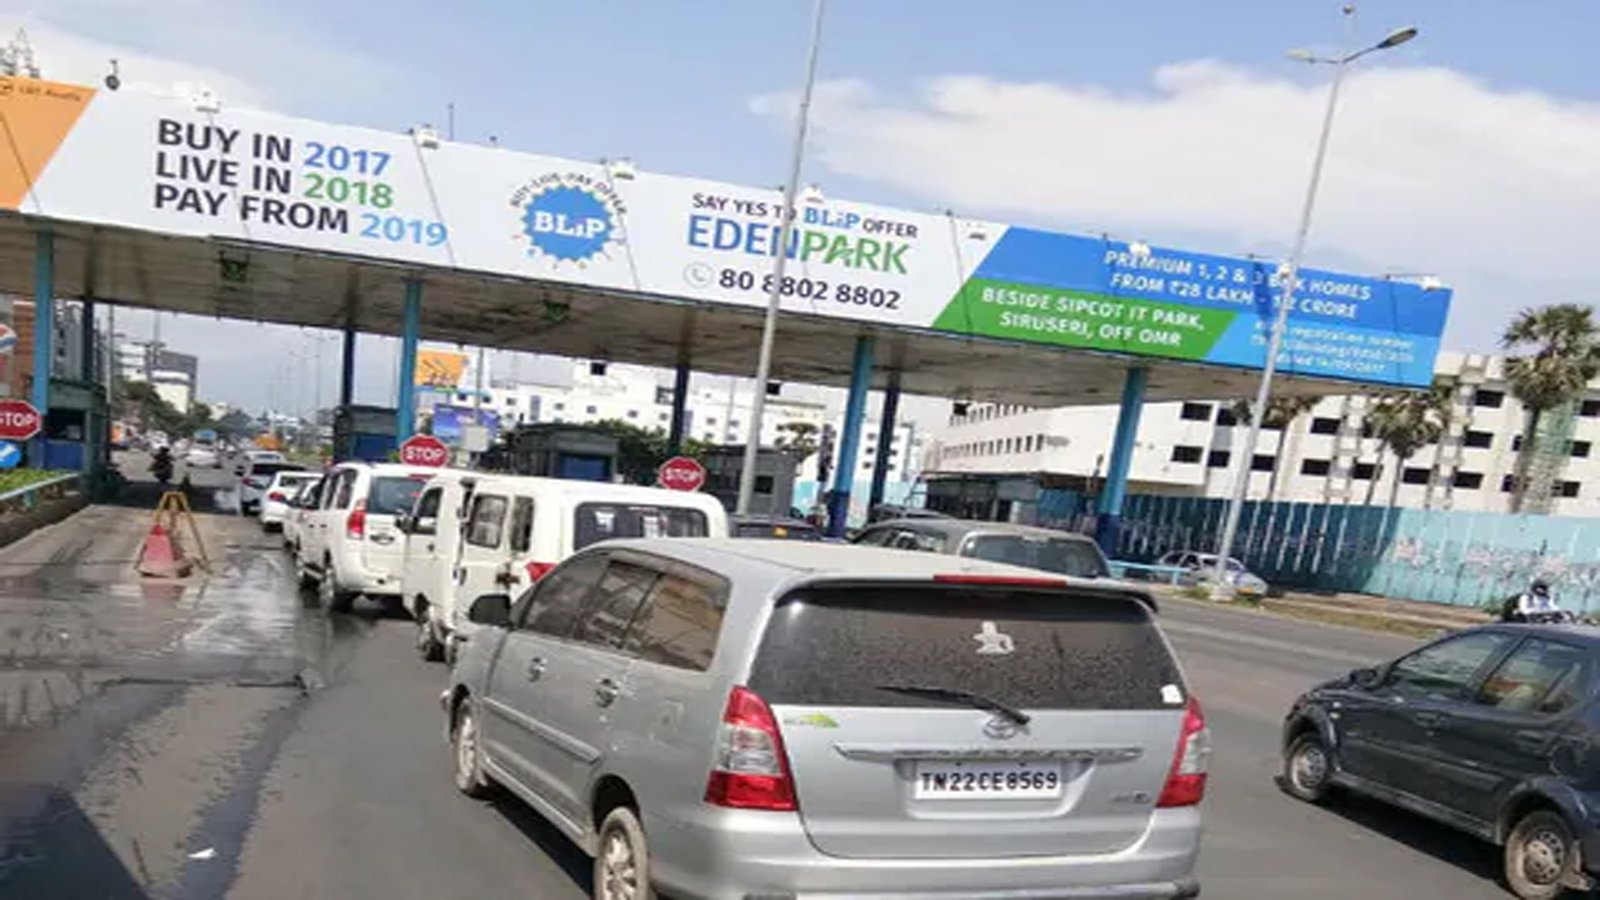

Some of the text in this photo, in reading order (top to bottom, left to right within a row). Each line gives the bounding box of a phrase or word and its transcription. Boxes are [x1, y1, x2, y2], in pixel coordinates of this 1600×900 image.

[159, 119, 391, 176] BUY IN 2017
[156, 152, 393, 209] LIVE IN 2018
[155, 184, 448, 247] PAY FROM 2019
[692, 193, 729, 212] SAY
[732, 198, 767, 218] YES
[804, 207, 861, 229] BLiP
[862, 218, 919, 239] OFFER
[719, 268, 901, 310] 80 8802 8802
[1104, 250, 1192, 276] PREMIUM
[1214, 265, 1228, 280] 2
[1232, 269, 1246, 283] &
[1268, 275, 1307, 291] BK
[1310, 278, 1372, 301] HOMES
[1110, 272, 1163, 293] FROM
[1206, 284, 1254, 303] LAKH
[1299, 299, 1359, 319] CRORE
[982, 287, 1205, 331] BESIDE SIPCOT IT PARK,
[999, 311, 1183, 347] SIRUSERI, OFF OMR
[405, 445, 444, 461] STOP
[665, 468, 700, 483] STOP
[921, 771, 1058, 791] TN22CE8569
